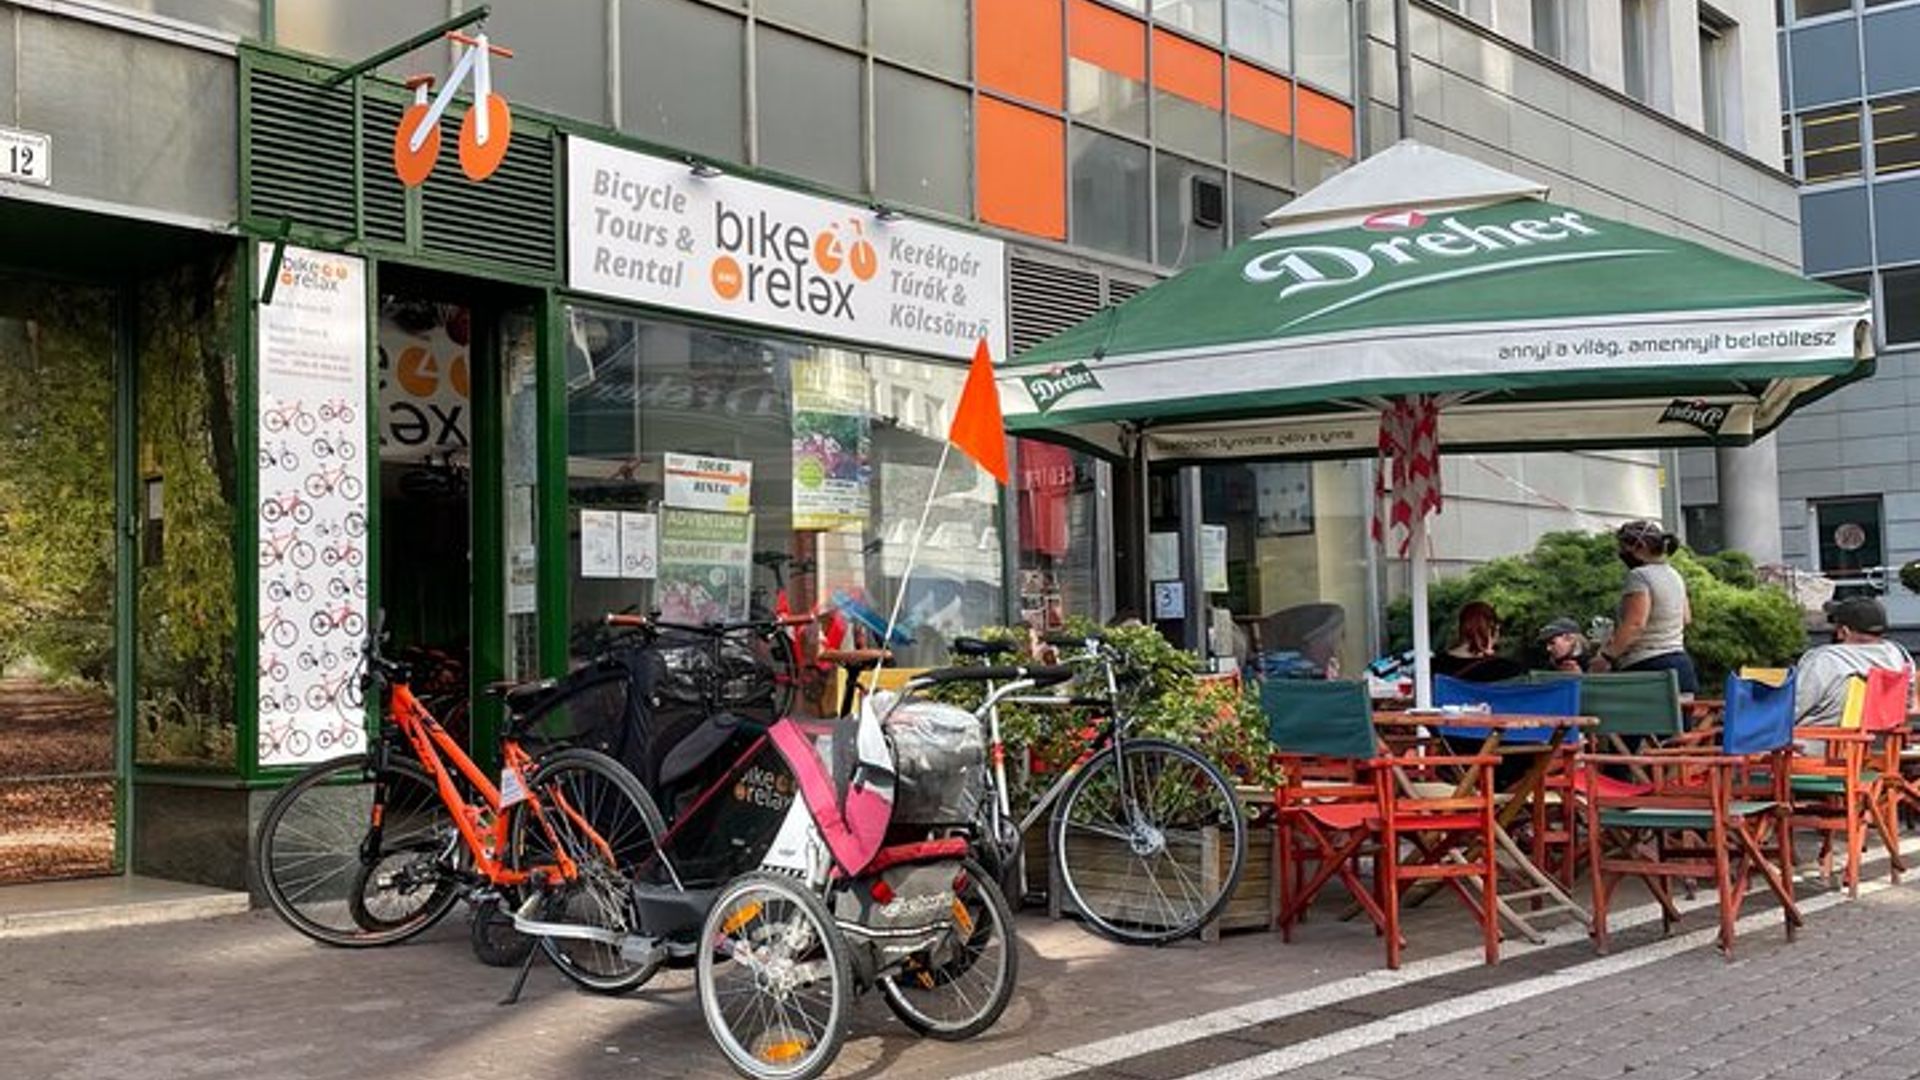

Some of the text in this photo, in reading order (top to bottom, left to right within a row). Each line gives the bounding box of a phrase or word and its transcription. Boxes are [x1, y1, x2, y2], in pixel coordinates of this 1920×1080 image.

[10, 145, 33, 176] 12
[594, 169, 687, 214] Bicycle
[595, 206, 695, 253] Tours &
[716, 201, 809, 266] bike
[594, 246, 684, 288] Rental
[890, 236, 981, 278] Kerékpár
[1243, 208, 1595, 301] Dreher
[891, 269, 967, 306] Túrák &
[1499, 341, 1551, 360] annyi
[1555, 343, 1568, 357] a
[1629, 333, 1721, 354] amennyit
[1725, 330, 1836, 349] beletöltesz
[1030, 371, 1092, 402] Dreher
